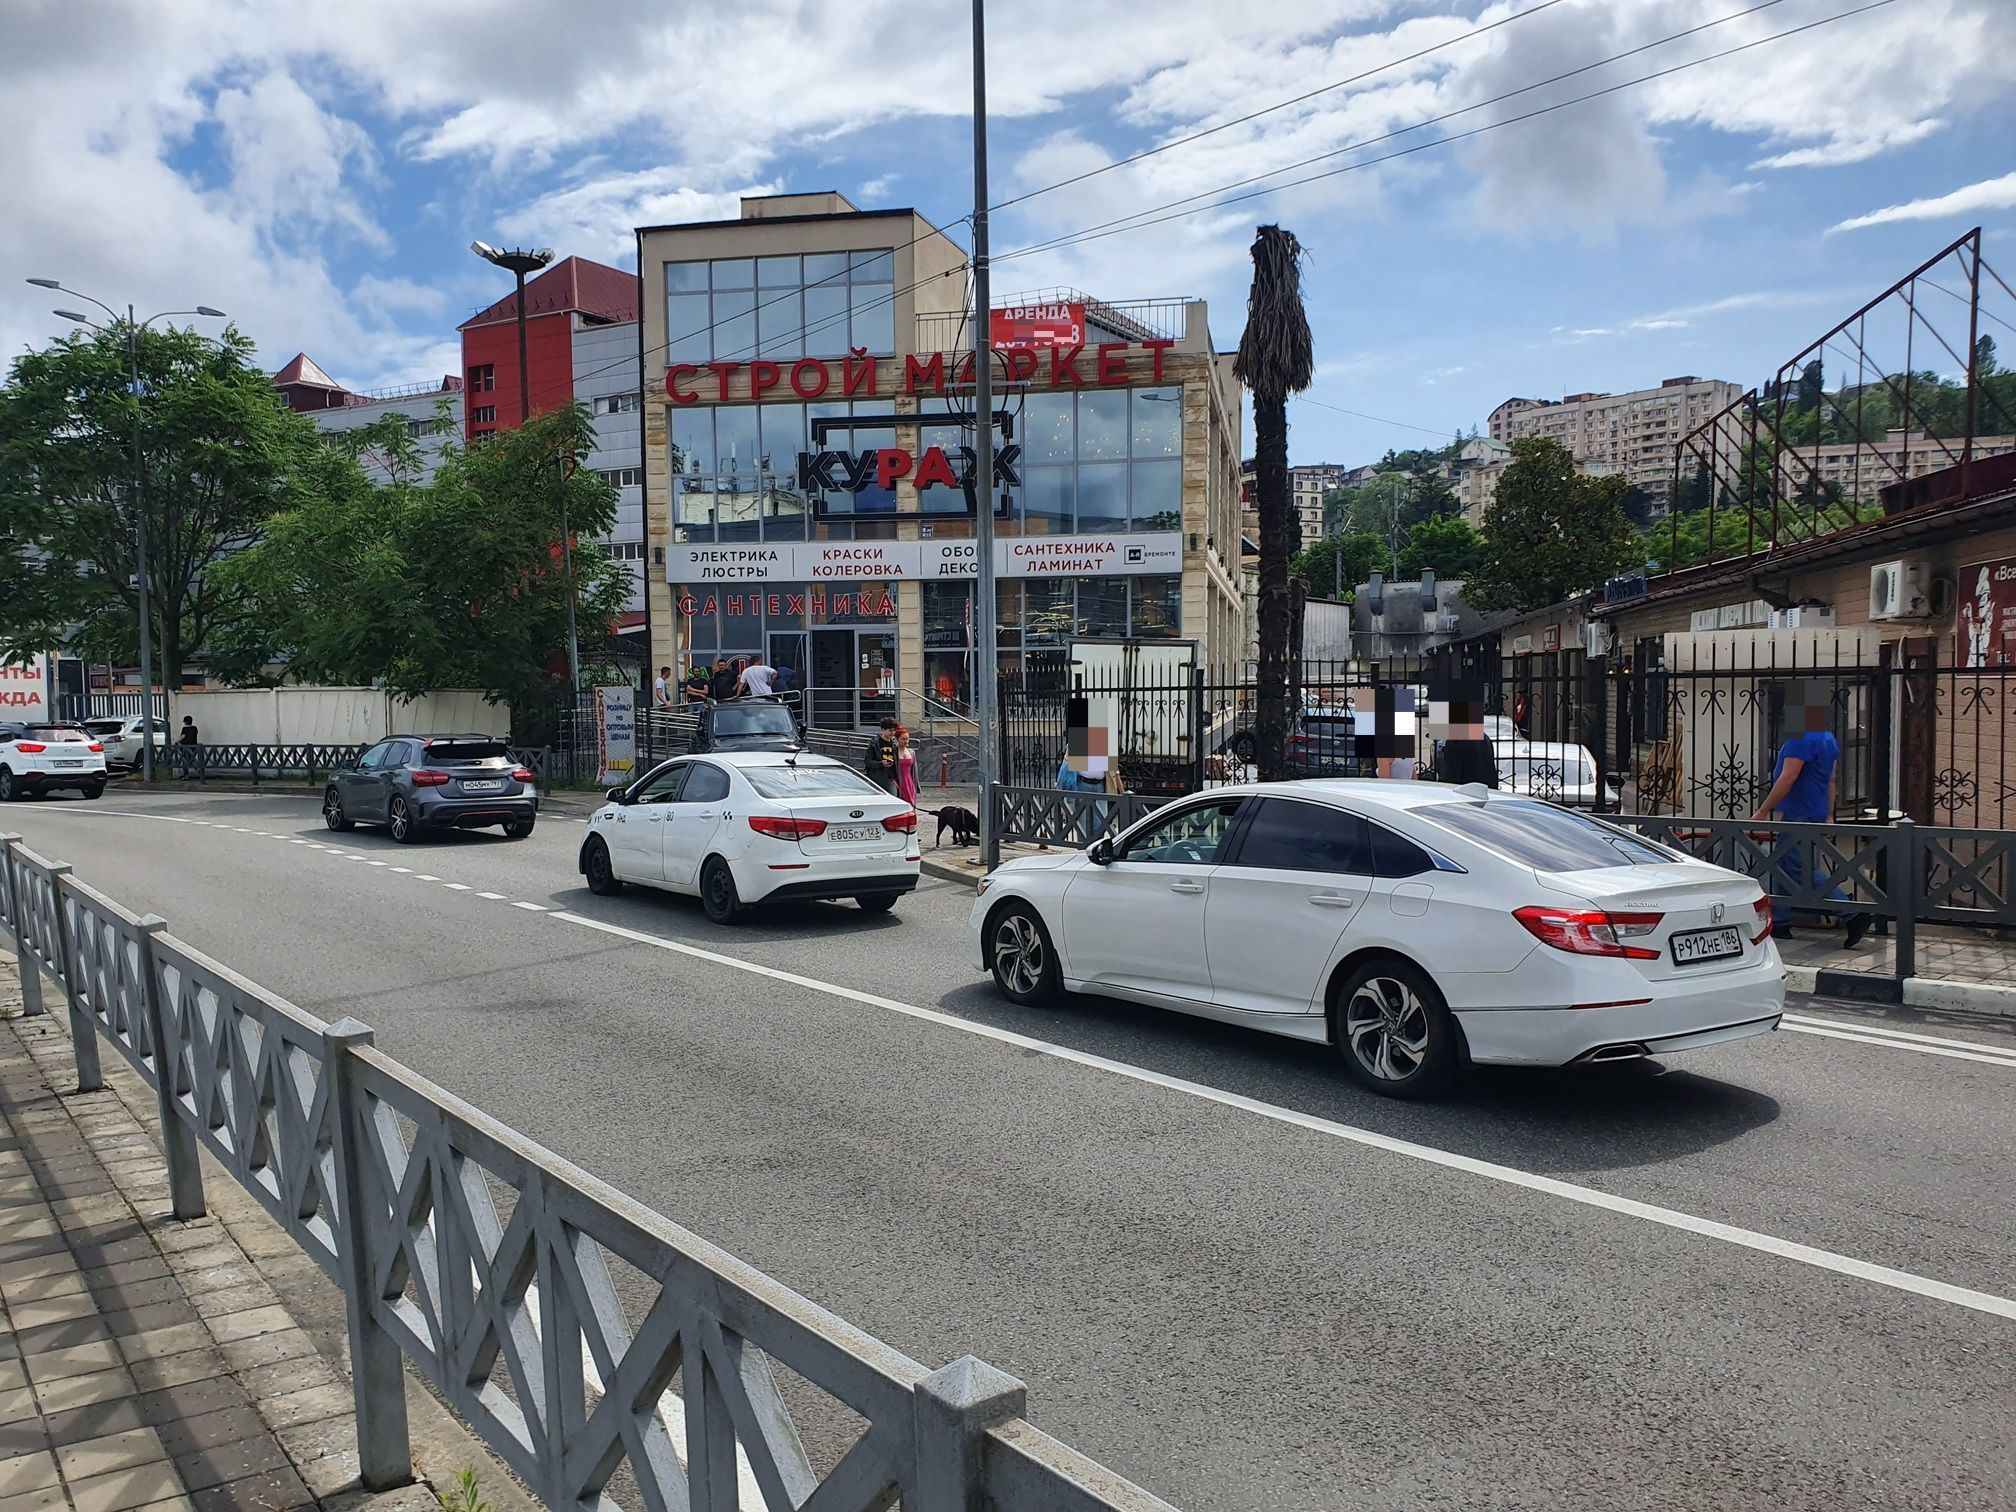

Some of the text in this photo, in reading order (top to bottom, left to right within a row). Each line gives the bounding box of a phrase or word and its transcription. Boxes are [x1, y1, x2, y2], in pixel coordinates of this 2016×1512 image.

[1004, 304, 1071, 320] АРЕНДА
[666, 346, 876, 403] СТРОЙ
[823, 548, 883, 560] КРАСКИ
[942, 546, 978, 557] ОБО
[1014, 541, 1115, 556] САНТЕХНИКА
[690, 550, 778, 562] ЭЛЕКТРИКА
[701, 566, 768, 578] ЛЮСТРЫ
[812, 564, 903, 576] КОЛЕРОВКА
[1027, 559, 1103, 572] ЛАМИНАТ
[679, 593, 896, 617] САНТЕХНИКА
[1678, 931, 1738, 958] Р912НЕ 186
